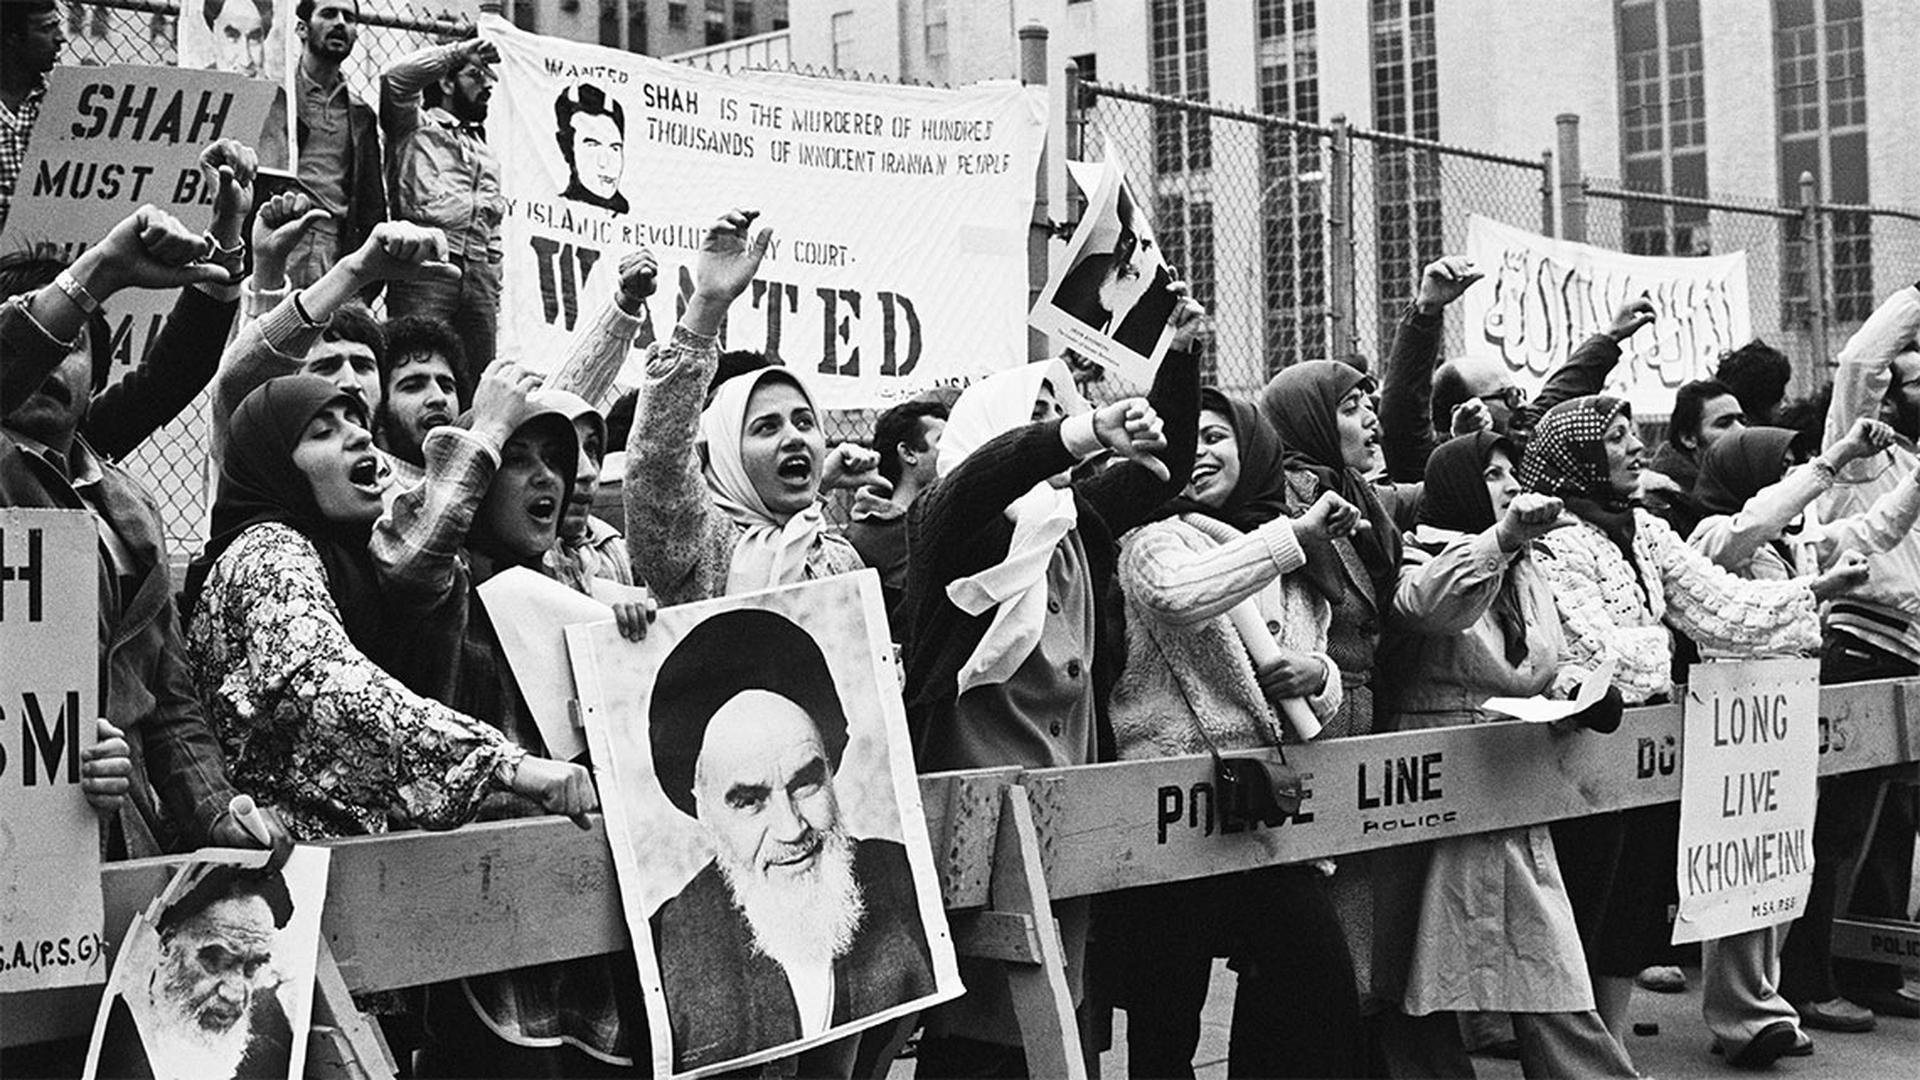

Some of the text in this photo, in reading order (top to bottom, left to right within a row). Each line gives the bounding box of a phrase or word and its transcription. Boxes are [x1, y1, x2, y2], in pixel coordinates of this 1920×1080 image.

[545, 58, 628, 84] WANTED
[71, 83, 234, 143] SHAH
[643, 83, 698, 114] SHAH
[720, 98, 738, 122] IS
[750, 103, 782, 129] THE
[792, 109, 883, 136] MURDERER
[893, 116, 912, 137] OF
[647, 117, 754, 158] THOUSANDS
[771, 140, 791, 163] OF
[799, 143, 876, 172] INNOCENT
[881, 153, 948, 175] IRANIAN
[33, 160, 153, 202] MUST
[527, 202, 612, 245] ISLAMIC
[795, 240, 855, 266] COURT.
[1713, 694, 1788, 747] LONG
[1358, 752, 1443, 811] LINE
[1722, 770, 1780, 818] LIVE
[1363, 811, 1457, 835] POLICE
[1687, 829, 1807, 896] KHOMEINI
